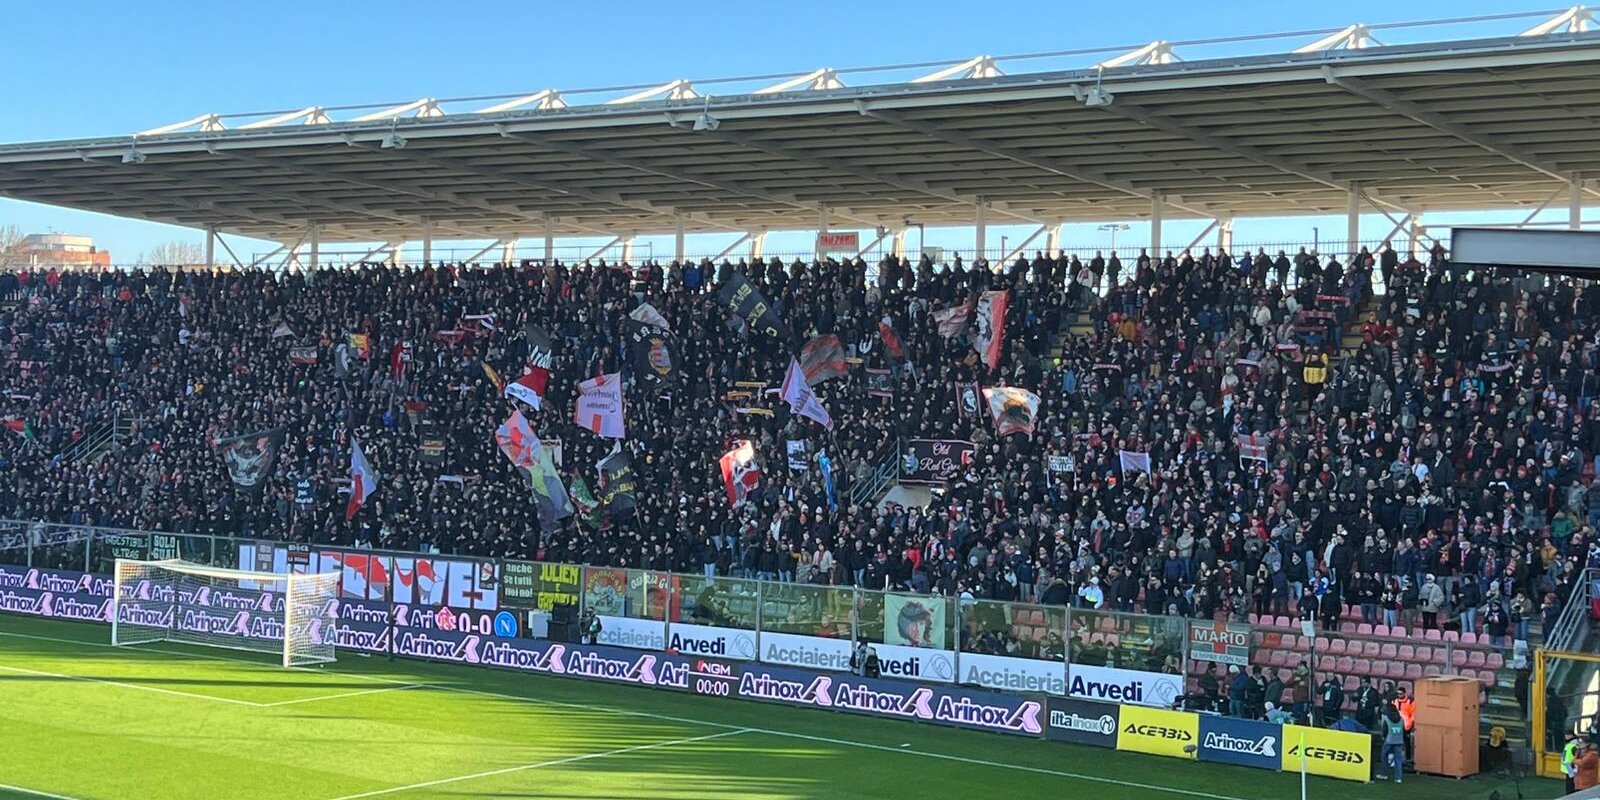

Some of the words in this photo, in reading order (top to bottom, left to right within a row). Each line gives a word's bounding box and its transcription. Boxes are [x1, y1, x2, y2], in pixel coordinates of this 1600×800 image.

[154, 535, 175, 548] SOLO
[505, 563, 532, 573] anche
[540, 564, 578, 586] JULIEN
[41, 573, 76, 593] Arinox
[342, 604, 389, 623] Arinox
[459, 613, 492, 635] 0-0
[1194, 629, 1246, 646] MARIO
[54, 597, 97, 619] Arinox
[118, 602, 162, 626] Arinox
[182, 610, 228, 633] Arinox
[323, 624, 376, 651] Arinox
[401, 632, 454, 658] Arinox
[481, 641, 539, 669] Arinox
[568, 651, 629, 679] Arinox
[659, 662, 689, 688] Ari
[740, 672, 804, 701] Arinox
[835, 684, 905, 715] Arinox
[936, 696, 1008, 728] Arinox
[600, 627, 664, 648] cciaieria
[670, 633, 726, 655] Arvedi
[766, 643, 850, 669] Acciaieria
[879, 657, 920, 677] vedi
[966, 665, 1065, 693] Acciaieria
[1070, 675, 1142, 702] Arvedi
[696, 678, 729, 696] 00:00
[1204, 732, 1253, 754] Arinox
